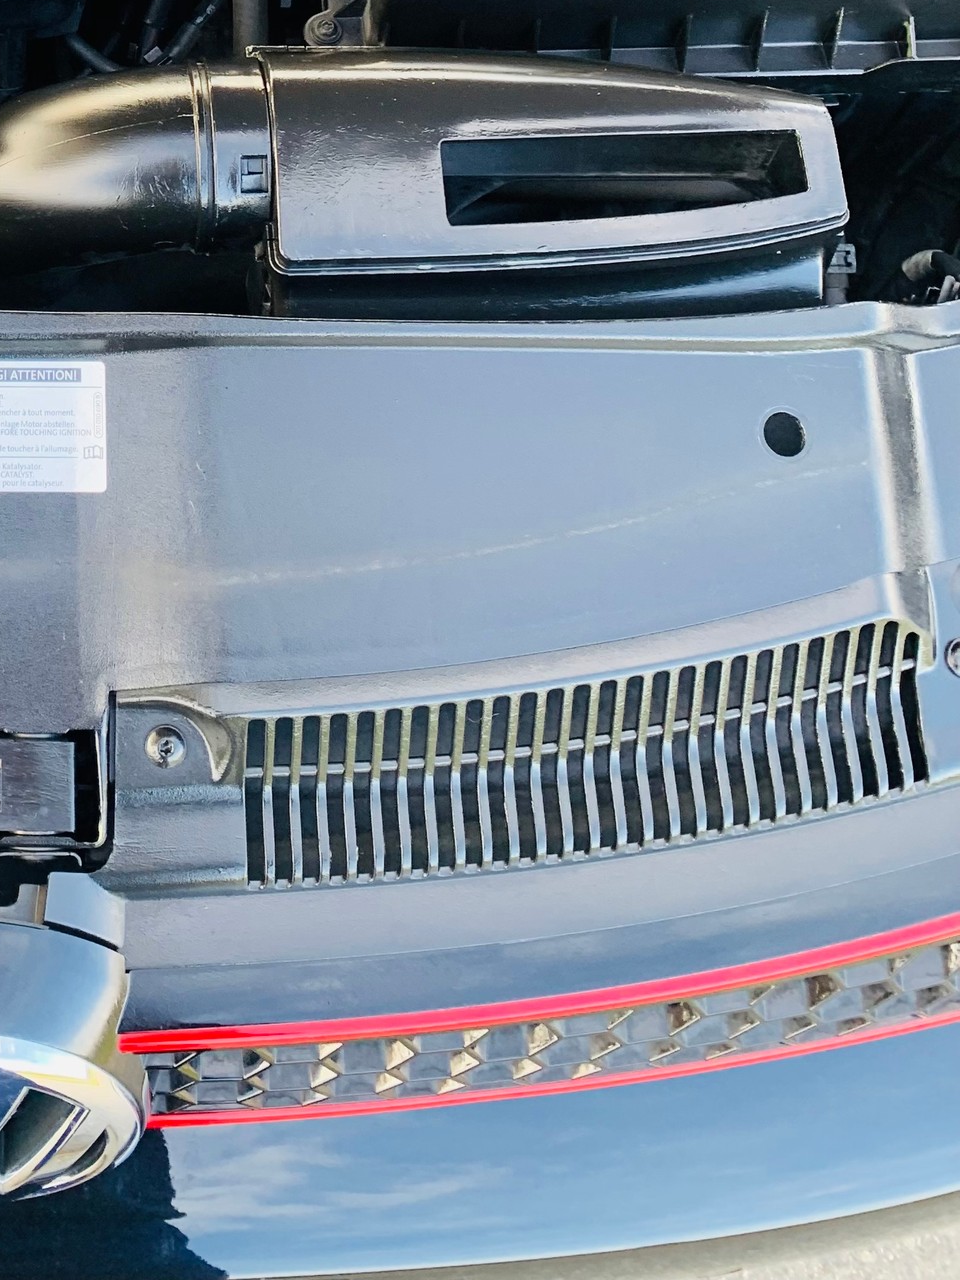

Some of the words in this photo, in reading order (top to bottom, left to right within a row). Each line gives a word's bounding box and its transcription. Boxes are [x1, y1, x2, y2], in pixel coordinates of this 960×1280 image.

[10, 370, 77, 381] ATTENTION!
[20, 428, 58, 436] TOUCHING
[60, 428, 92, 436] IGNITION
